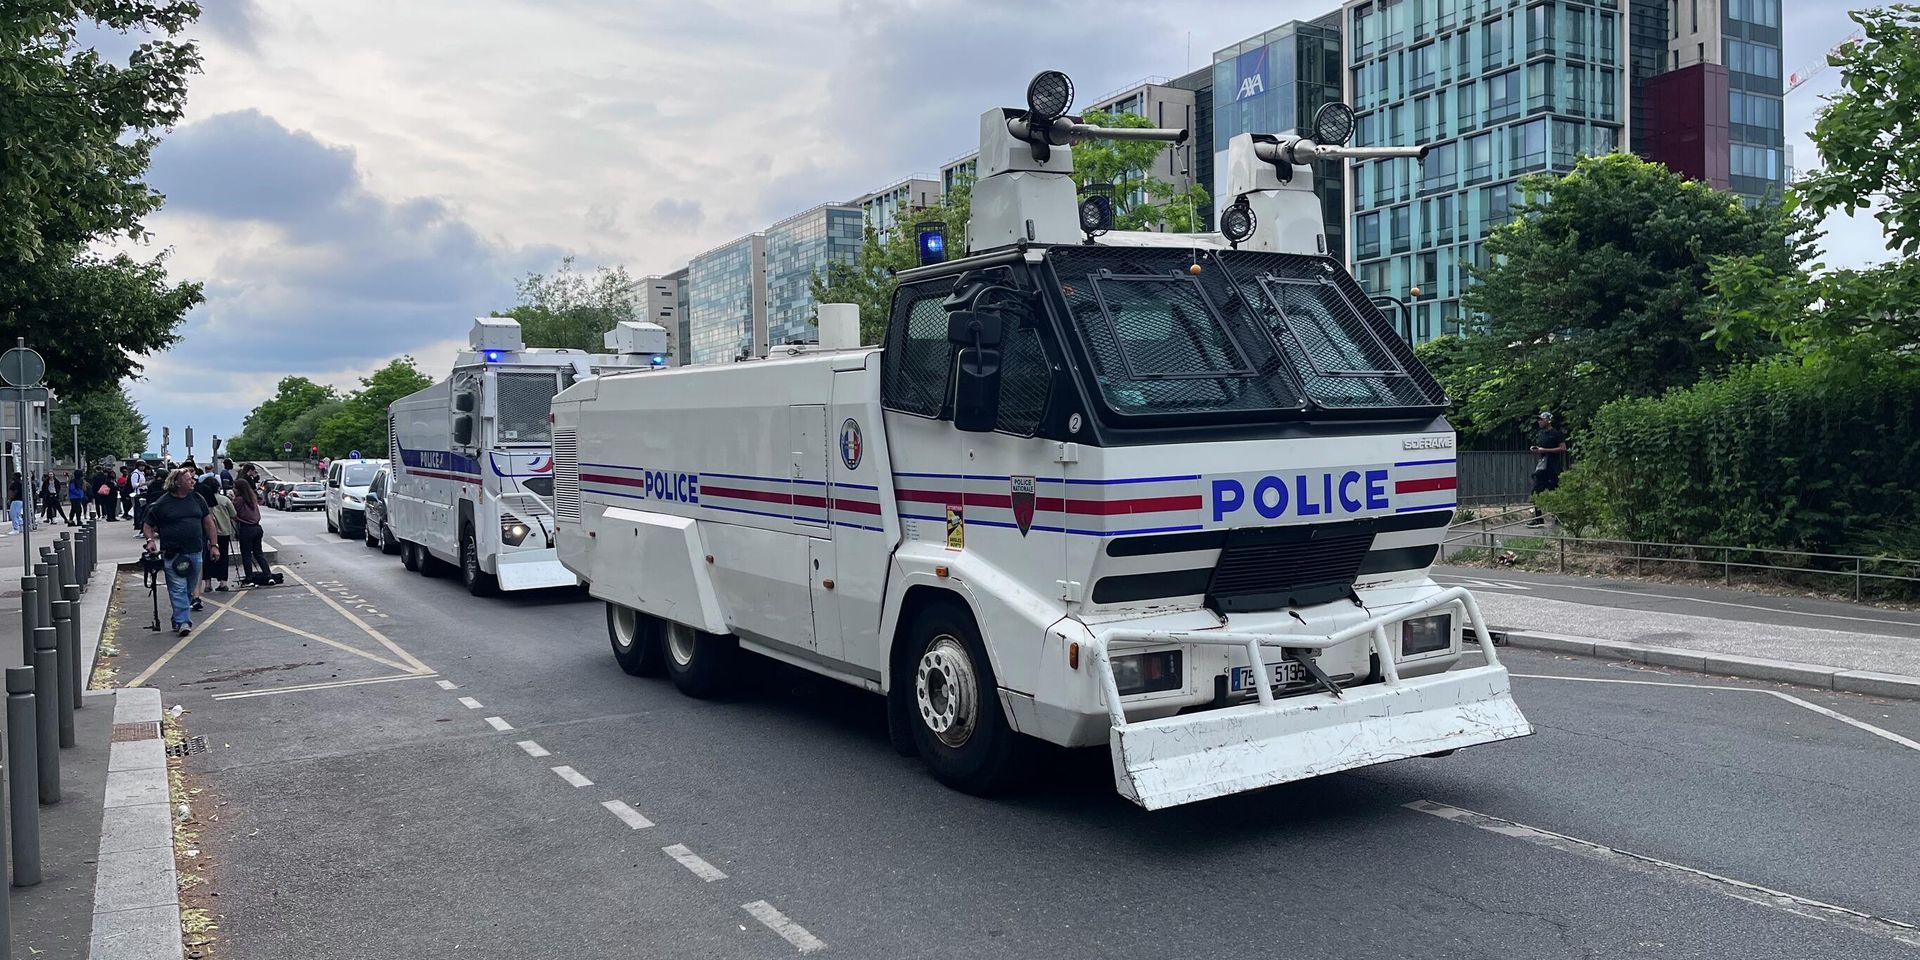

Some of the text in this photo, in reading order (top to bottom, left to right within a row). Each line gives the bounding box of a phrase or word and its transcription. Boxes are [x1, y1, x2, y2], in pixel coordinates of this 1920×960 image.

[1236, 73, 1264, 101] AXA
[1072, 417, 1079, 430] 2
[419, 451, 440, 469] POLICE
[645, 471, 699, 503] POLICE
[1212, 469, 1389, 521] POLICE
